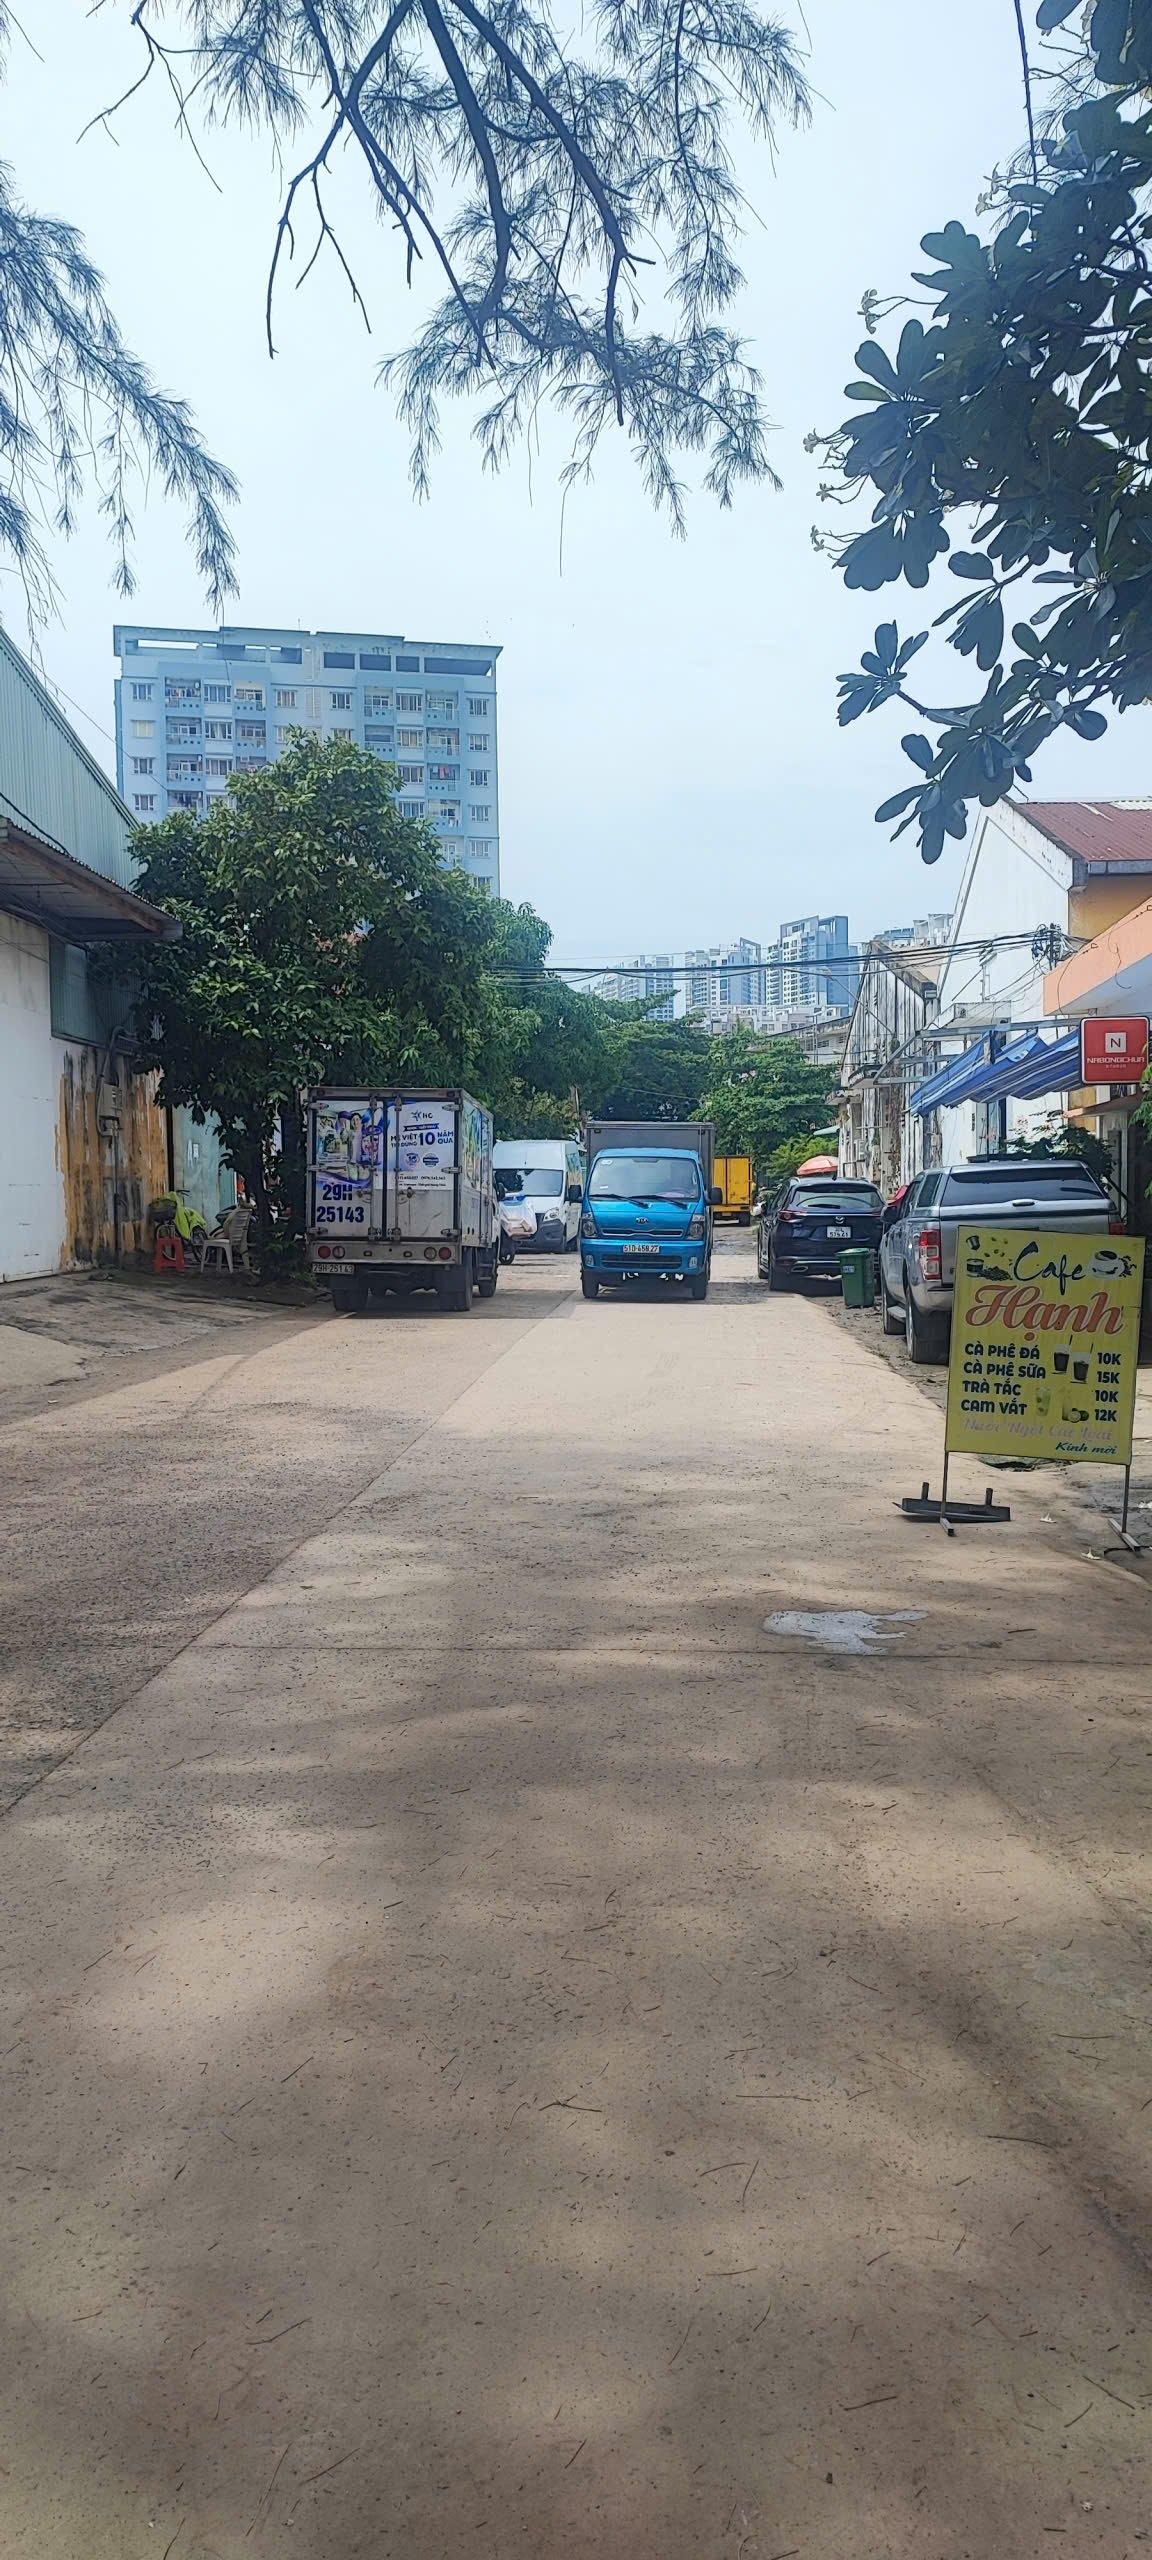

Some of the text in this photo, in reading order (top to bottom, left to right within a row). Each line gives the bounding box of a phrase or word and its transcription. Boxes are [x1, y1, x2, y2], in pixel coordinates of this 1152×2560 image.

[1110, 1038, 1121, 1048] N
[419, 1132, 436, 1146] 10
[323, 1183, 353, 1200] 29H
[316, 1206, 365, 1223] 25143
[1013, 1241, 1086, 1296] Cafe
[965, 1284, 1124, 1341] Hạnh
[964, 1341, 1040, 1360] CÀ PHÊ ĐÁ
[1097, 1352, 1121, 1366] 10K
[963, 1359, 1046, 1379] CÀ PHÊ SỮA
[1096, 1371, 1120, 1384] 15K
[962, 1378, 1021, 1396] TRÀ TẮC
[1095, 1390, 1119, 1403] 10K
[961, 1397, 1028, 1416] CAM VẮT
[1094, 1408, 1117, 1422] 12K
